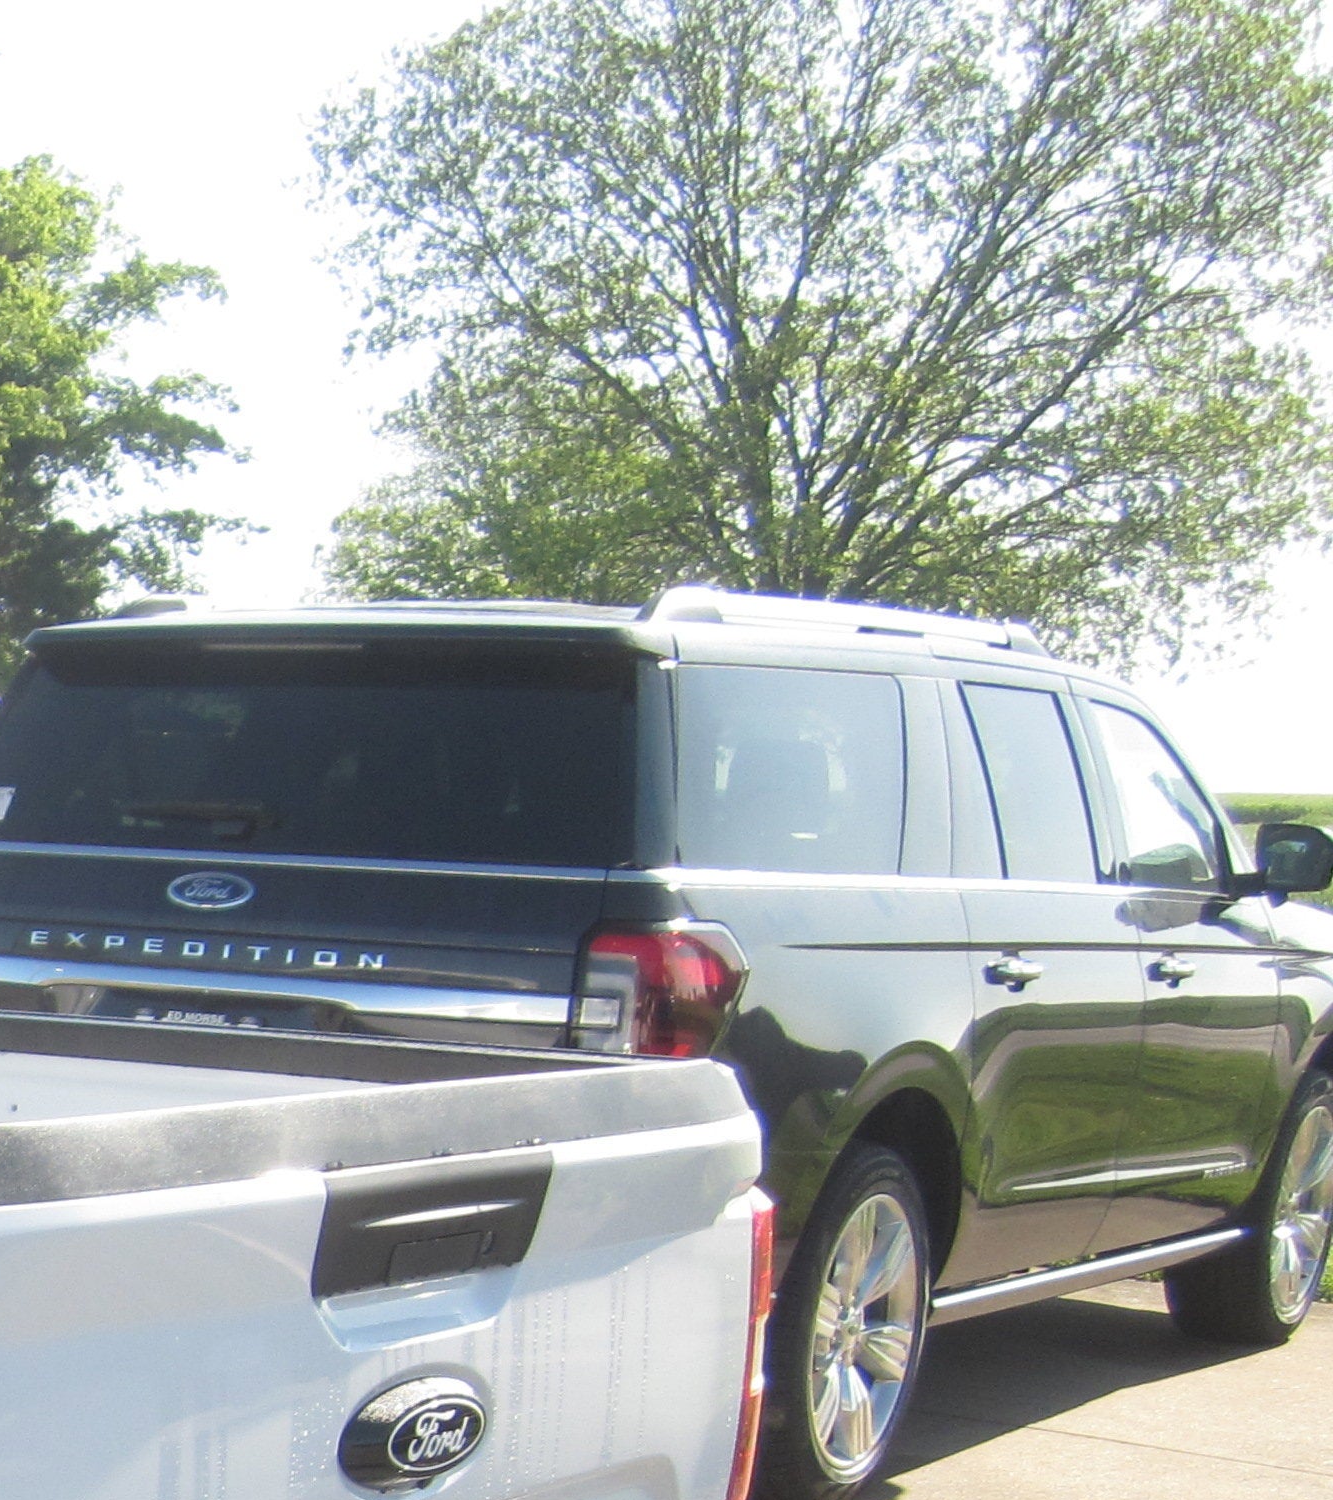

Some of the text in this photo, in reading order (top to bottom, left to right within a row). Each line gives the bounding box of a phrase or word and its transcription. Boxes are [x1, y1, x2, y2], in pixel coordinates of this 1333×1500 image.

[184, 878, 234, 899] Ford
[30, 930, 384, 970] EXPEDITION
[407, 1409, 470, 1462] Ford
